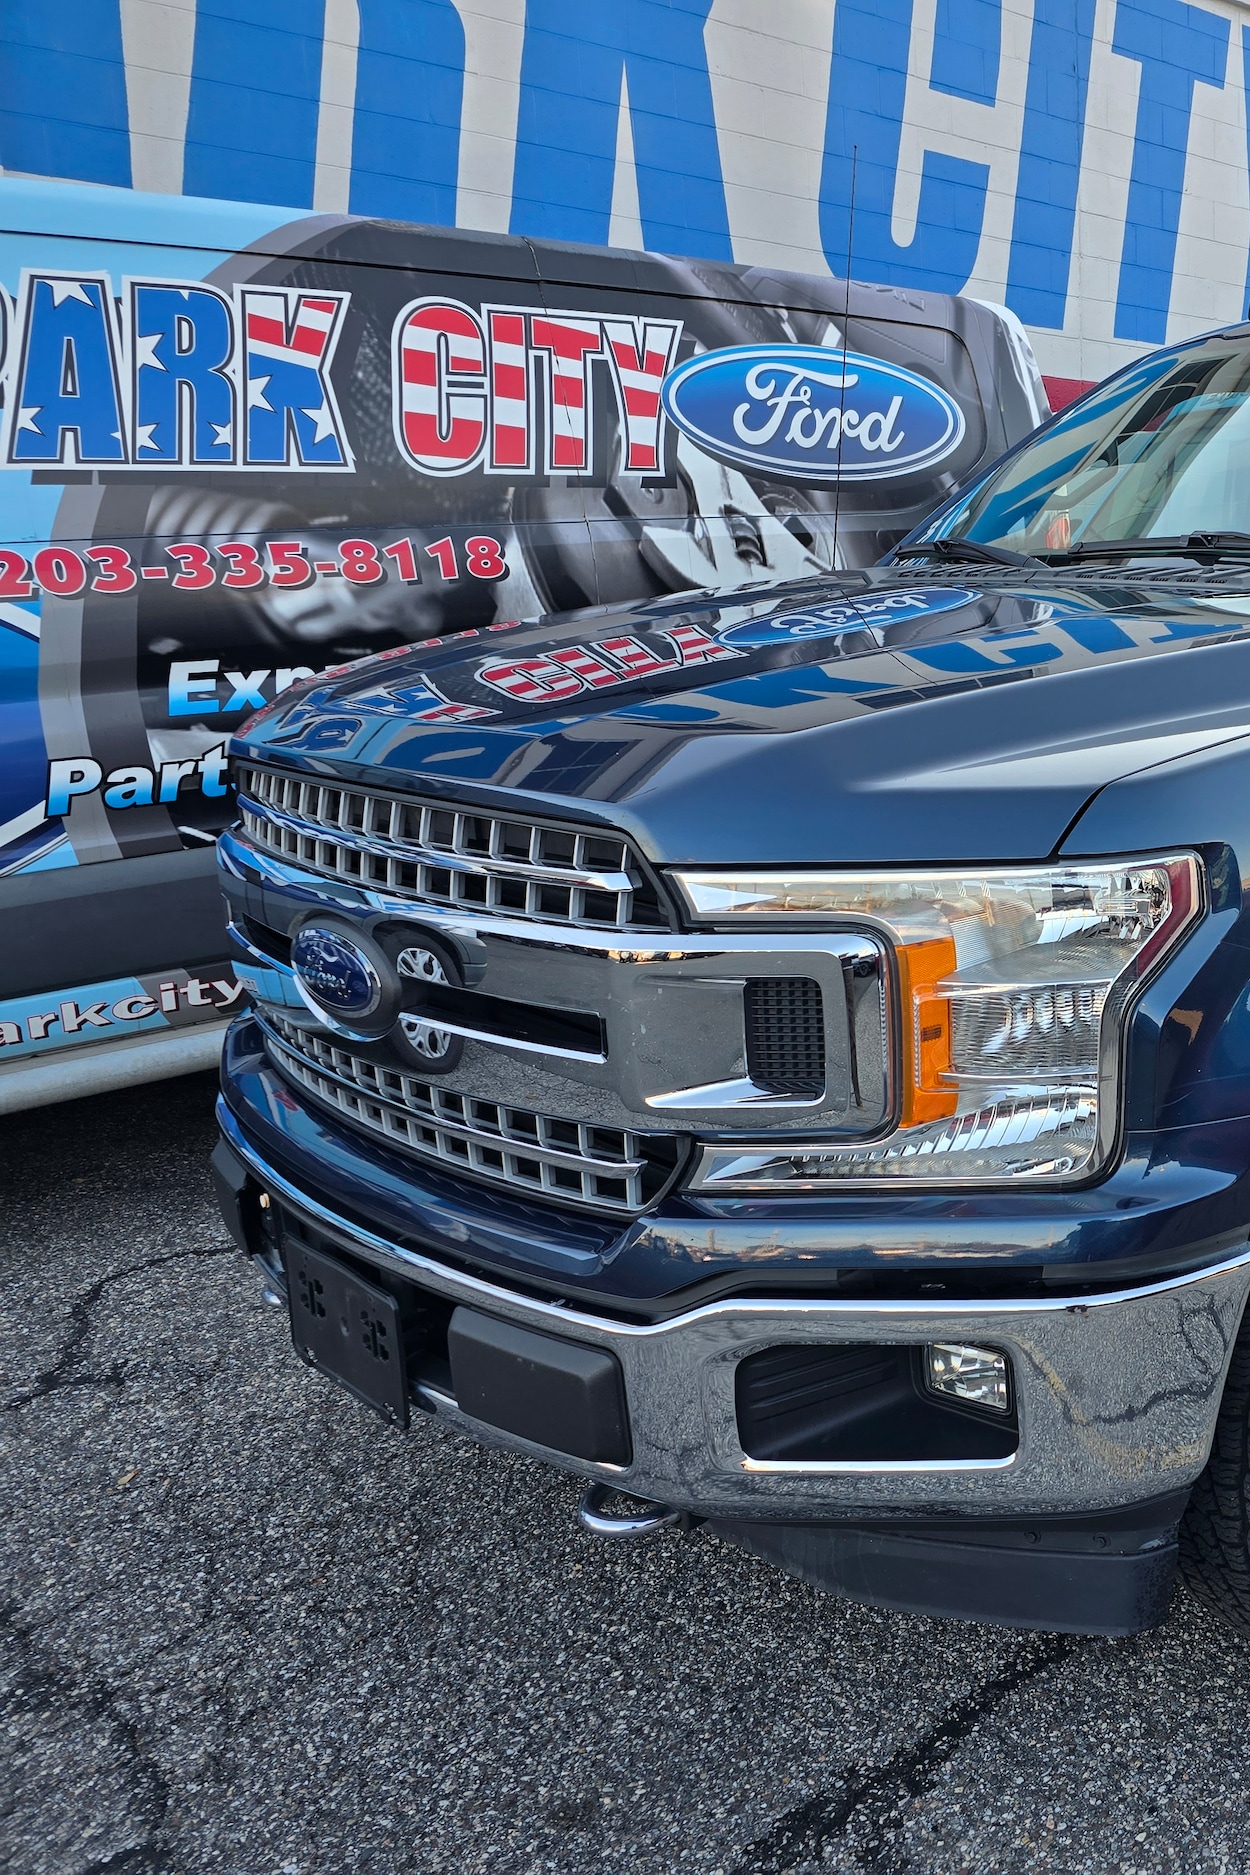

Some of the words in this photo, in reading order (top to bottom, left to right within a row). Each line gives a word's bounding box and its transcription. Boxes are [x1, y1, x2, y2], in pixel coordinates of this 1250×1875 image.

[0, 267, 354, 472] ARK
[392, 297, 684, 478] CITY
[732, 362, 905, 453] Ford
[0, 535, 510, 598] 203-335-8118
[44, 741, 238, 819] Part
